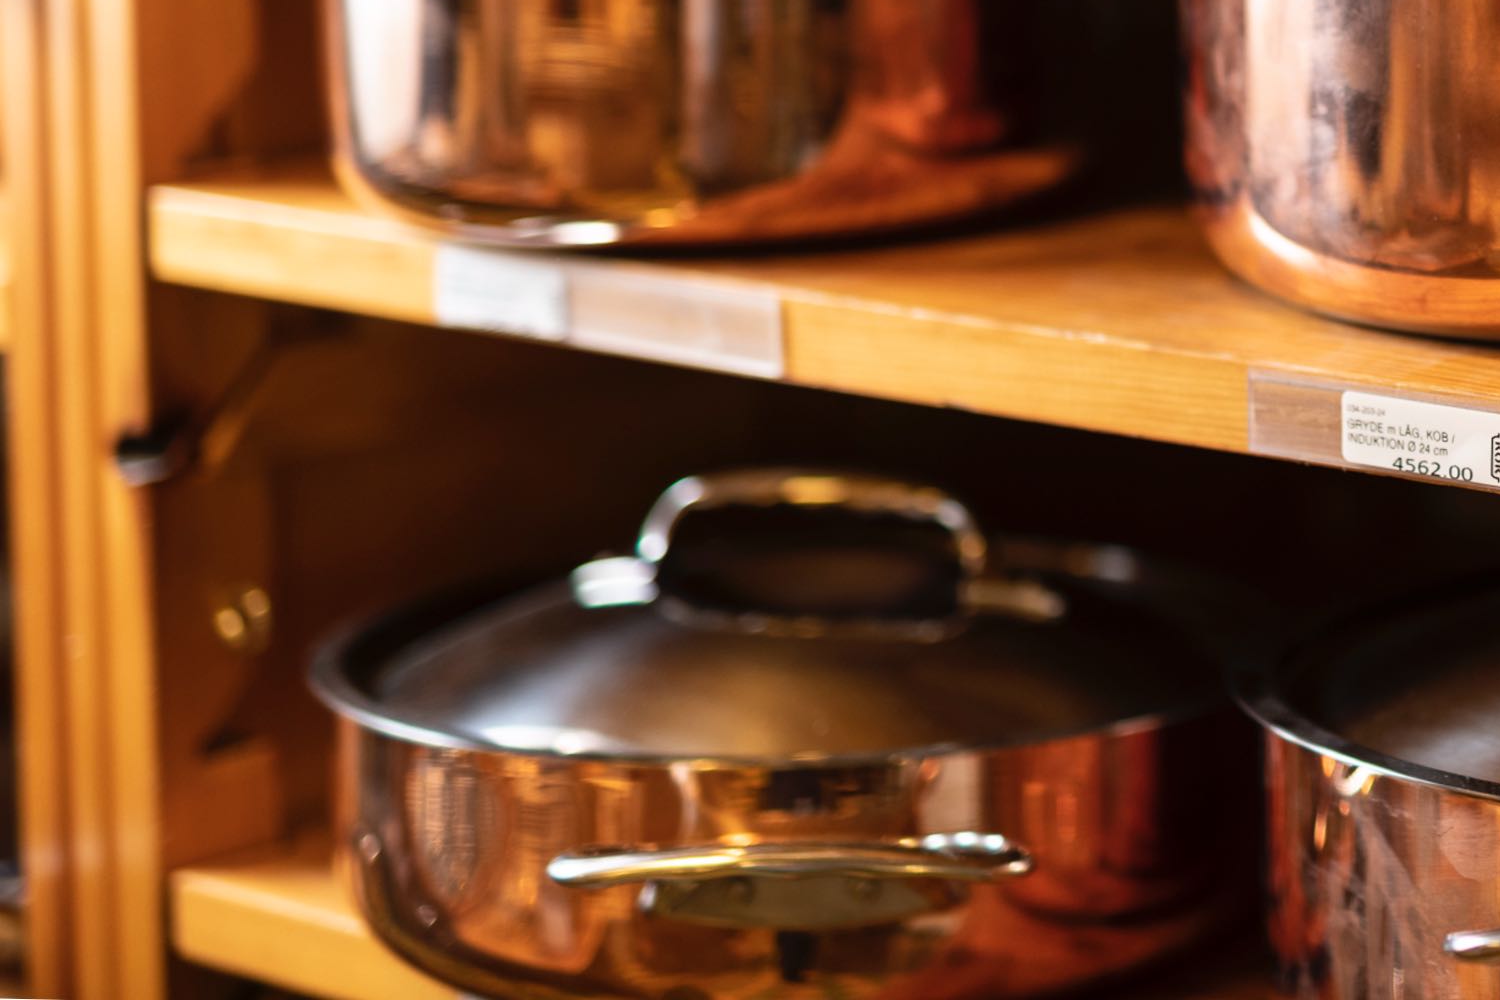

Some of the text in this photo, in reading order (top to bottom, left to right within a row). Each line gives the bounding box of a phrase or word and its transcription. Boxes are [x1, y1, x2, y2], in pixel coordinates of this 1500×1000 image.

[1348, 418, 1384, 434] GRYDE
[1387, 425, 1397, 434] m
[1348, 432, 1405, 451] INDUKTION
[1419, 443, 1430, 455] 24
[1433, 447, 1448, 456] cm
[1392, 456, 1473, 482] 4562.00
